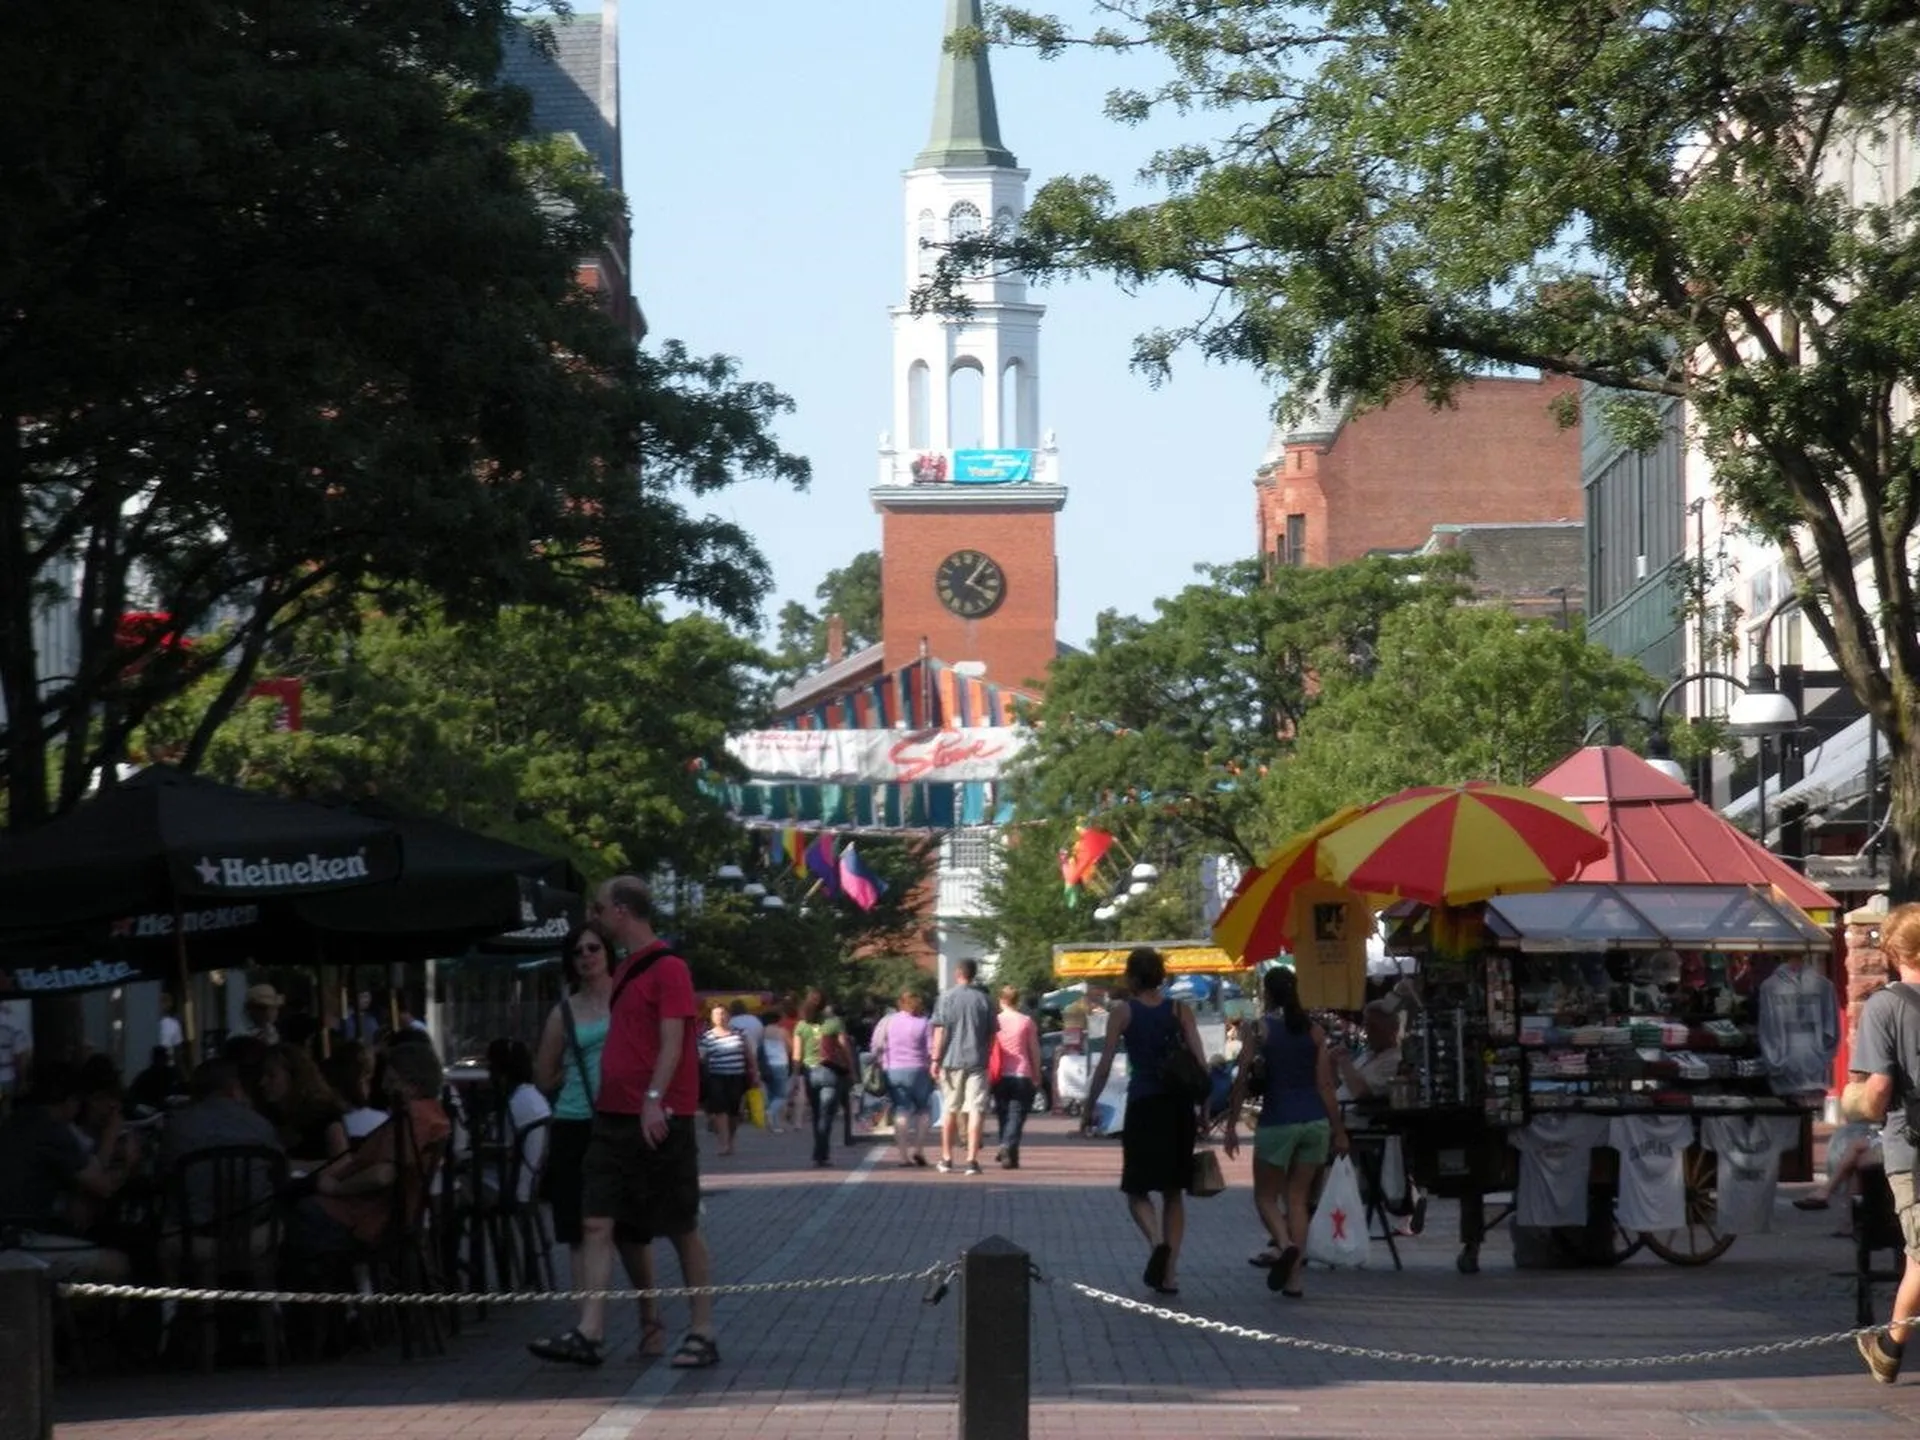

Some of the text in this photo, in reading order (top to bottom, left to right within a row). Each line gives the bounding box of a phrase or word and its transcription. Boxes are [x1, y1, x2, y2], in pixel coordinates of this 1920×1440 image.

[221, 853, 369, 887] Heineken
[136, 904, 259, 936] Heneken
[14, 959, 141, 991] Heineke
